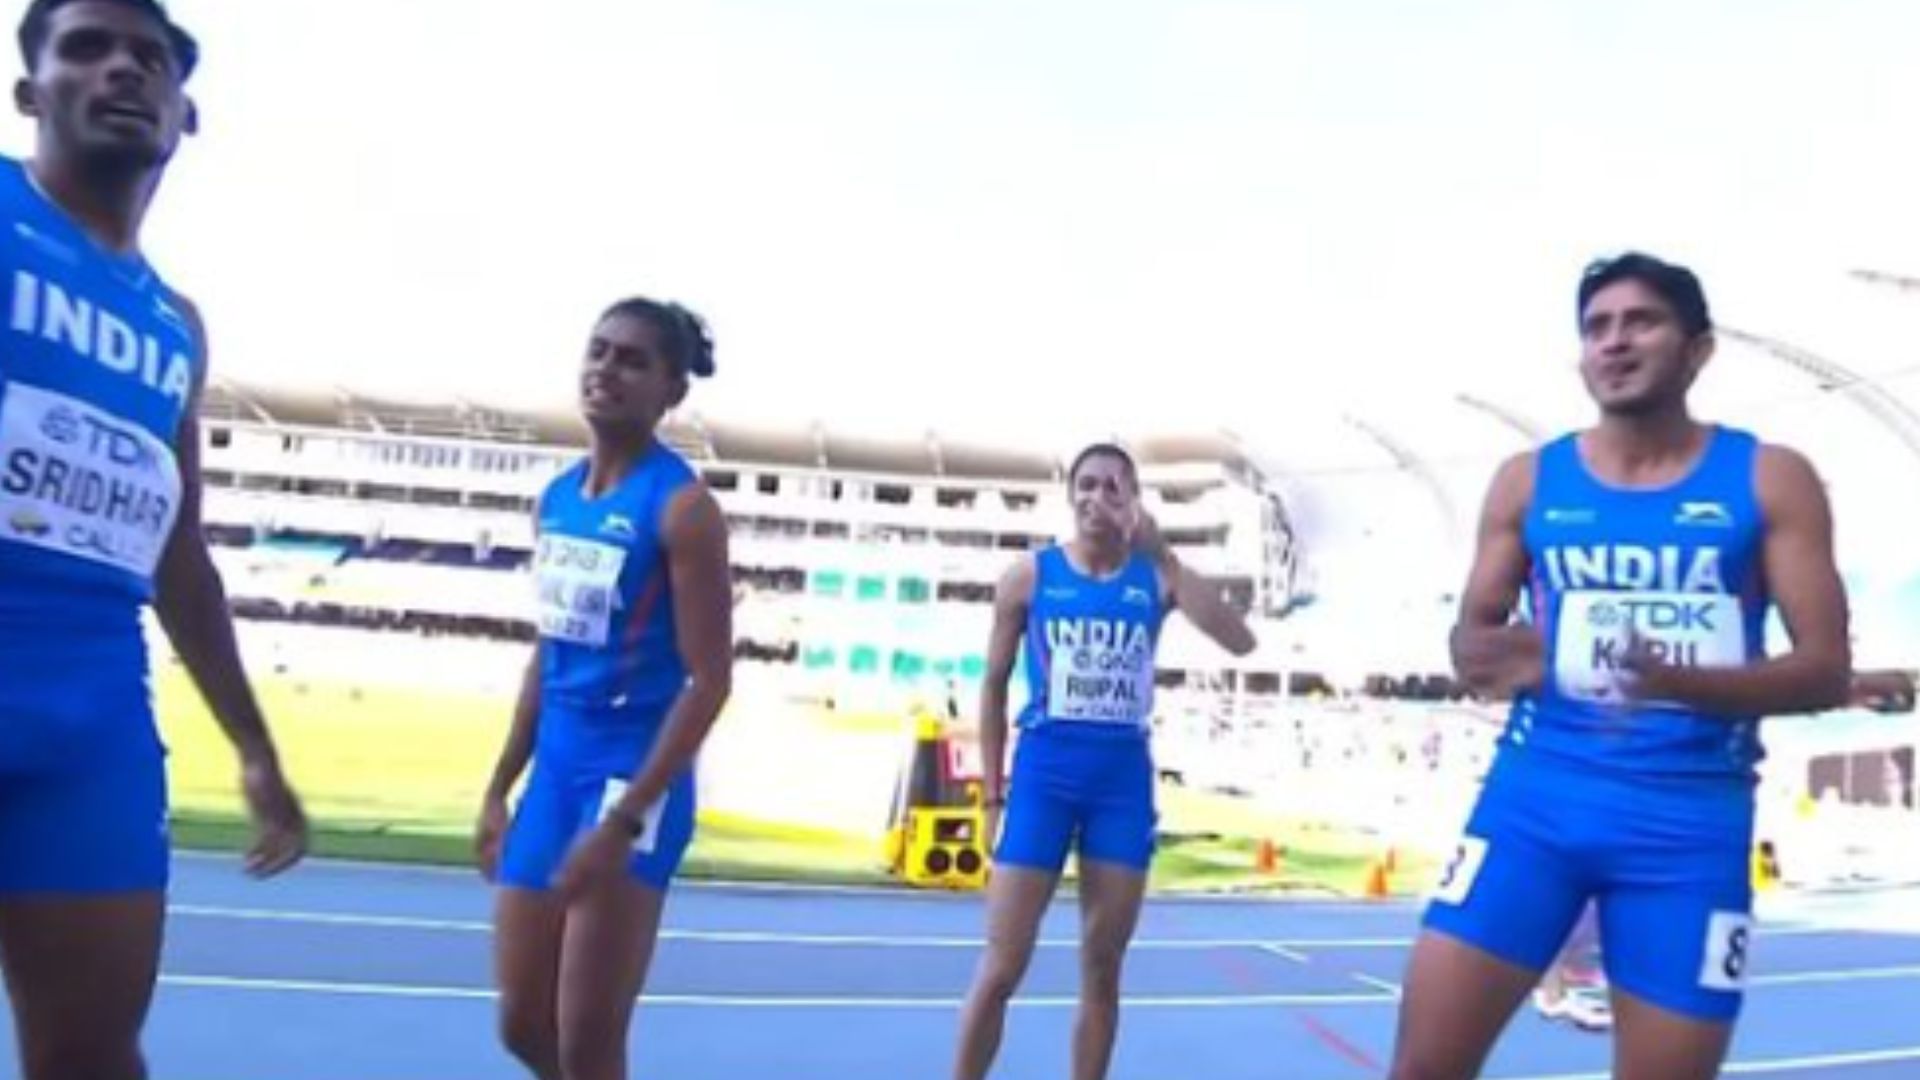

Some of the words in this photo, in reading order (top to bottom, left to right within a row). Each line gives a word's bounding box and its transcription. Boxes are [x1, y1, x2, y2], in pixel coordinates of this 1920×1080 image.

[10, 269, 191, 408] INDIA
[1, 447, 170, 535] SRIDHAR
[1544, 544, 1727, 593] INDIA
[1046, 617, 1150, 653] INDIA
[1618, 600, 1717, 632] TDK
[1066, 676, 1139, 702] RUPAL
[1722, 926, 1748, 980] 8
